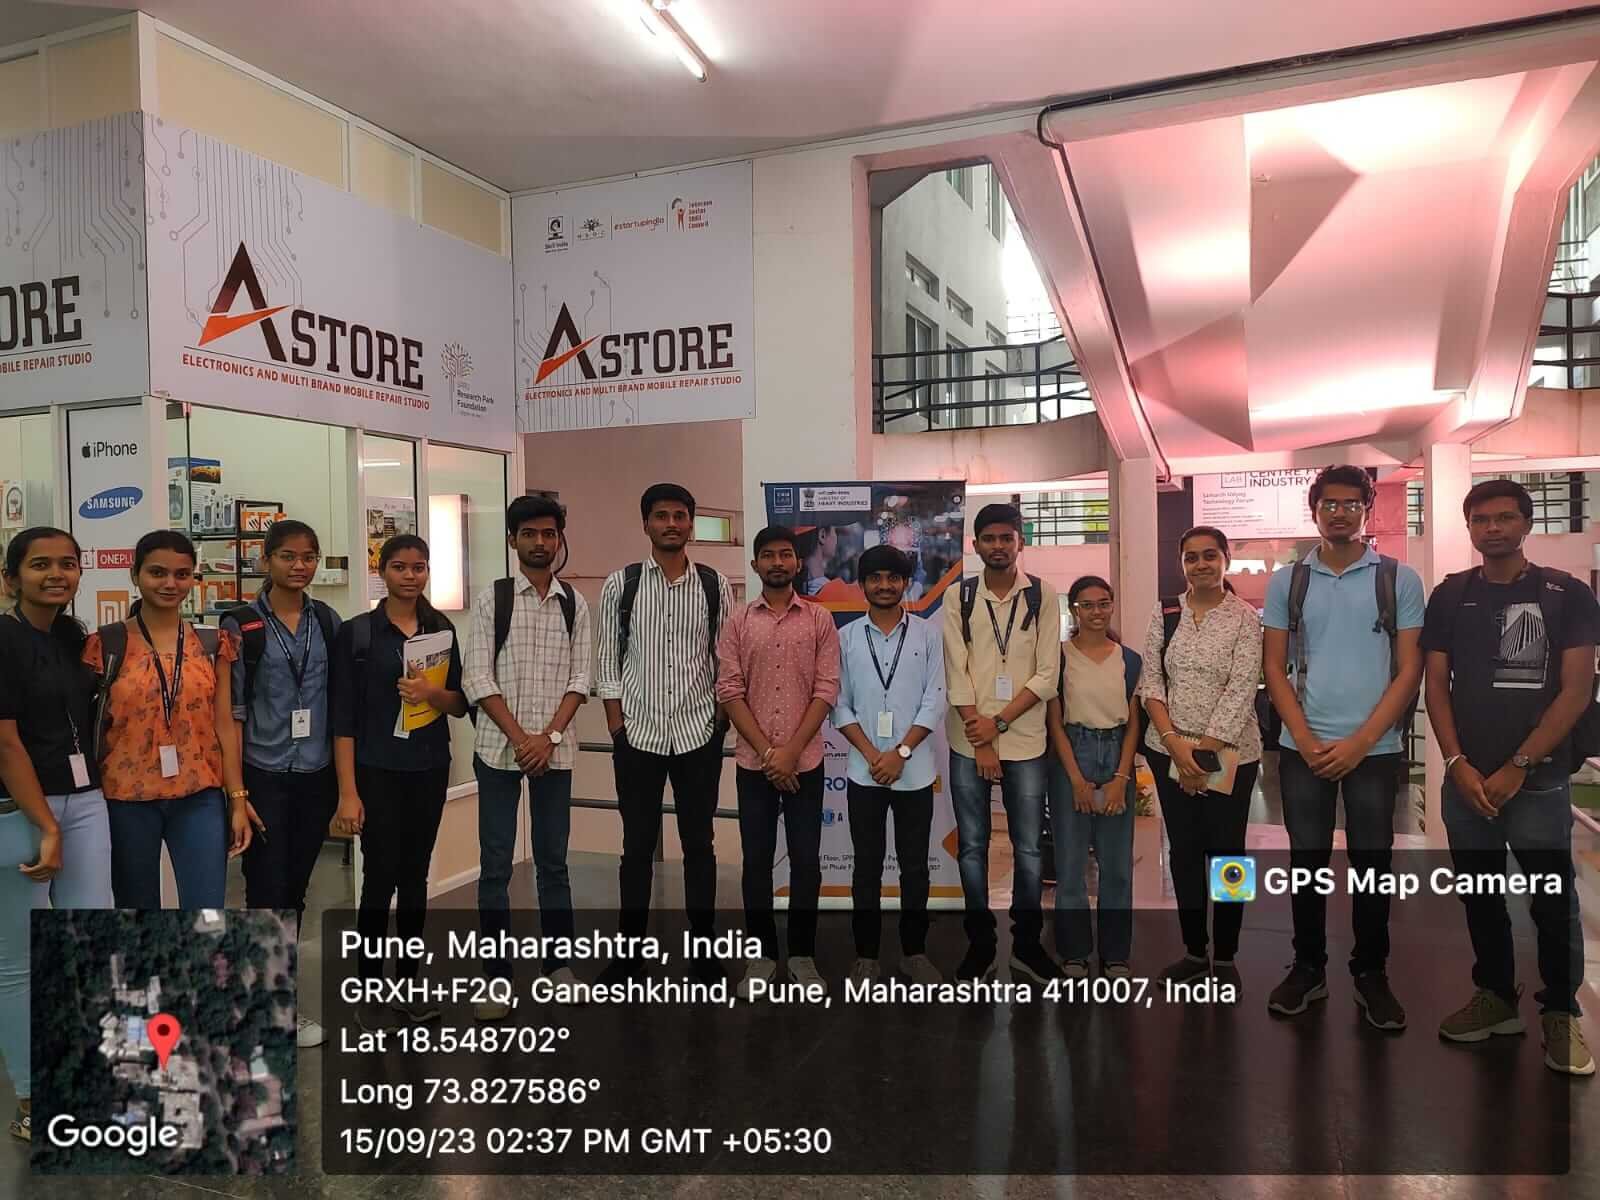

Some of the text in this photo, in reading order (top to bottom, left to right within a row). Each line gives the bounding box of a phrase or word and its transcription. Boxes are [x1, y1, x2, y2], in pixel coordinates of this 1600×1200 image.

[0, 351, 93, 374] BILE REPAIR STUDIO
[183, 353, 430, 410] ELECTRONICS AND MULTI BRAND MOBILE REPAIR STUDIO
[525, 375, 742, 401] ELECTRONICS AND MULTI BRAND MOBILE REPAIR STUDIO
[93, 441, 138, 458] iPhone
[1249, 476, 1312, 487] INDUSTRY
[87, 496, 135, 510] SAMSUNG
[100, 552, 136, 565] ONEPLU
